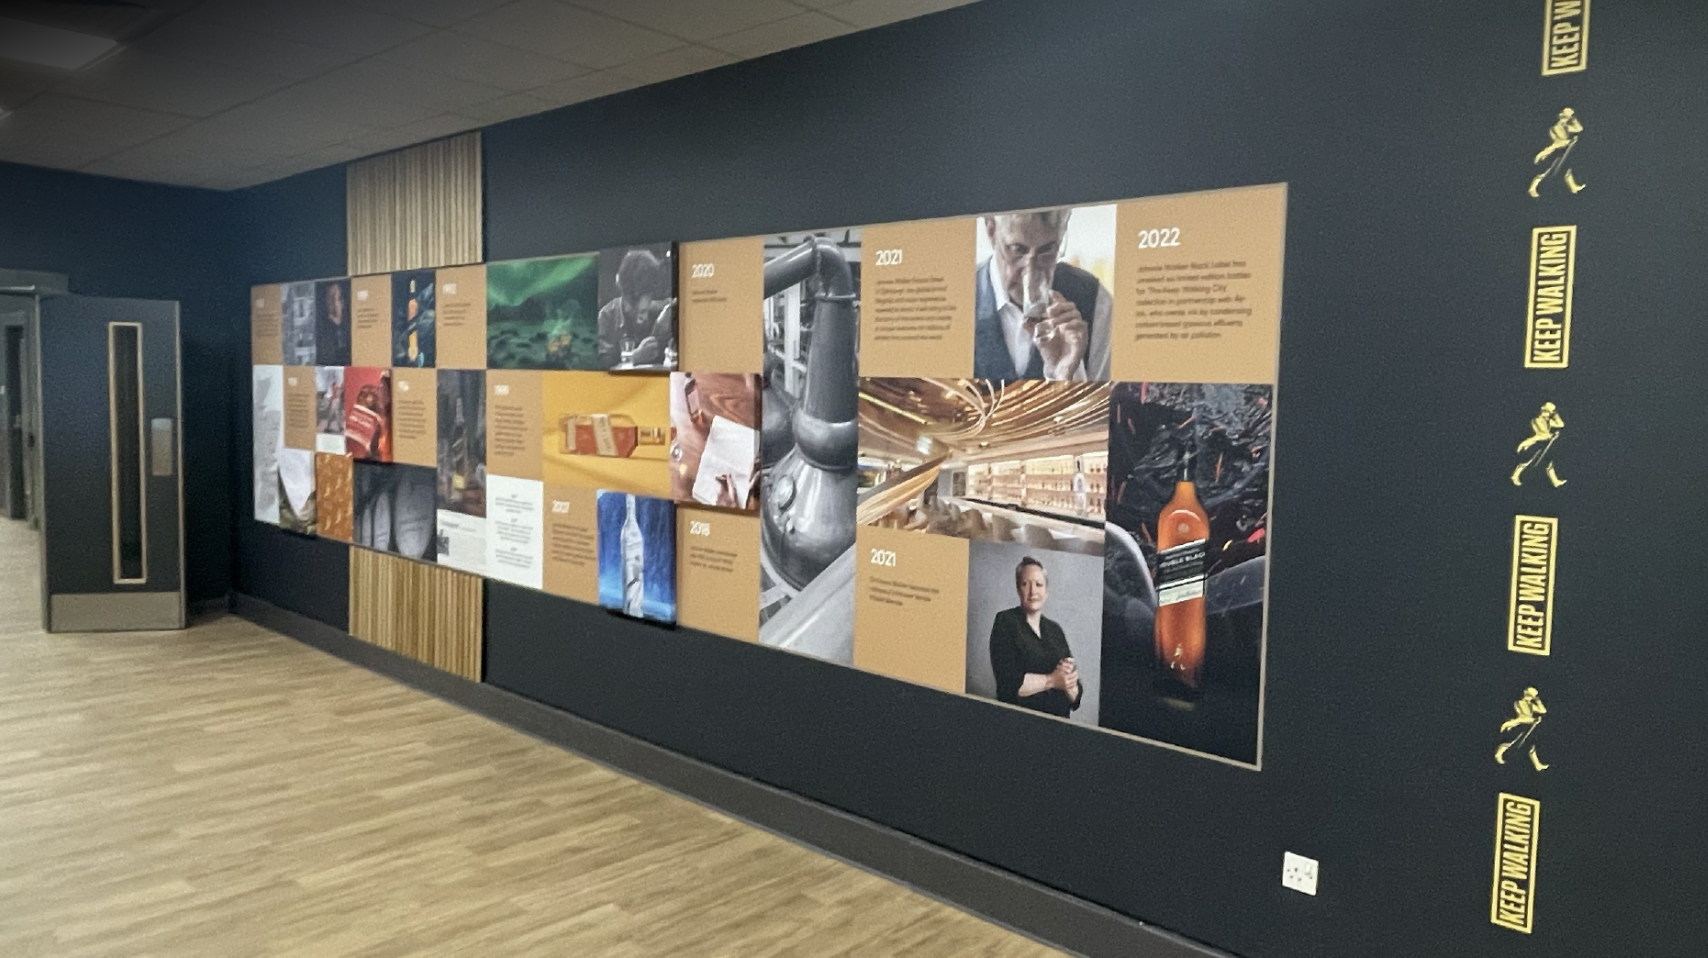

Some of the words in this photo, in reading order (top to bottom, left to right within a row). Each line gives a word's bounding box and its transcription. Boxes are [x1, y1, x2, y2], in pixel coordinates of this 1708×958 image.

[1551, 22, 1580, 67] KEEP
[875, 249, 902, 265] 2021
[1138, 227, 1180, 249] 2022
[691, 263, 715, 278] 2020
[1536, 232, 1567, 315] WALKING
[1533, 318, 1562, 361] KEEP
[870, 548, 896, 567] 2021
[1519, 523, 1549, 601] WALKING
[1516, 604, 1545, 648] KEEP
[1502, 801, 1531, 879] WALKING
[1500, 880, 1526, 925] KEEP
